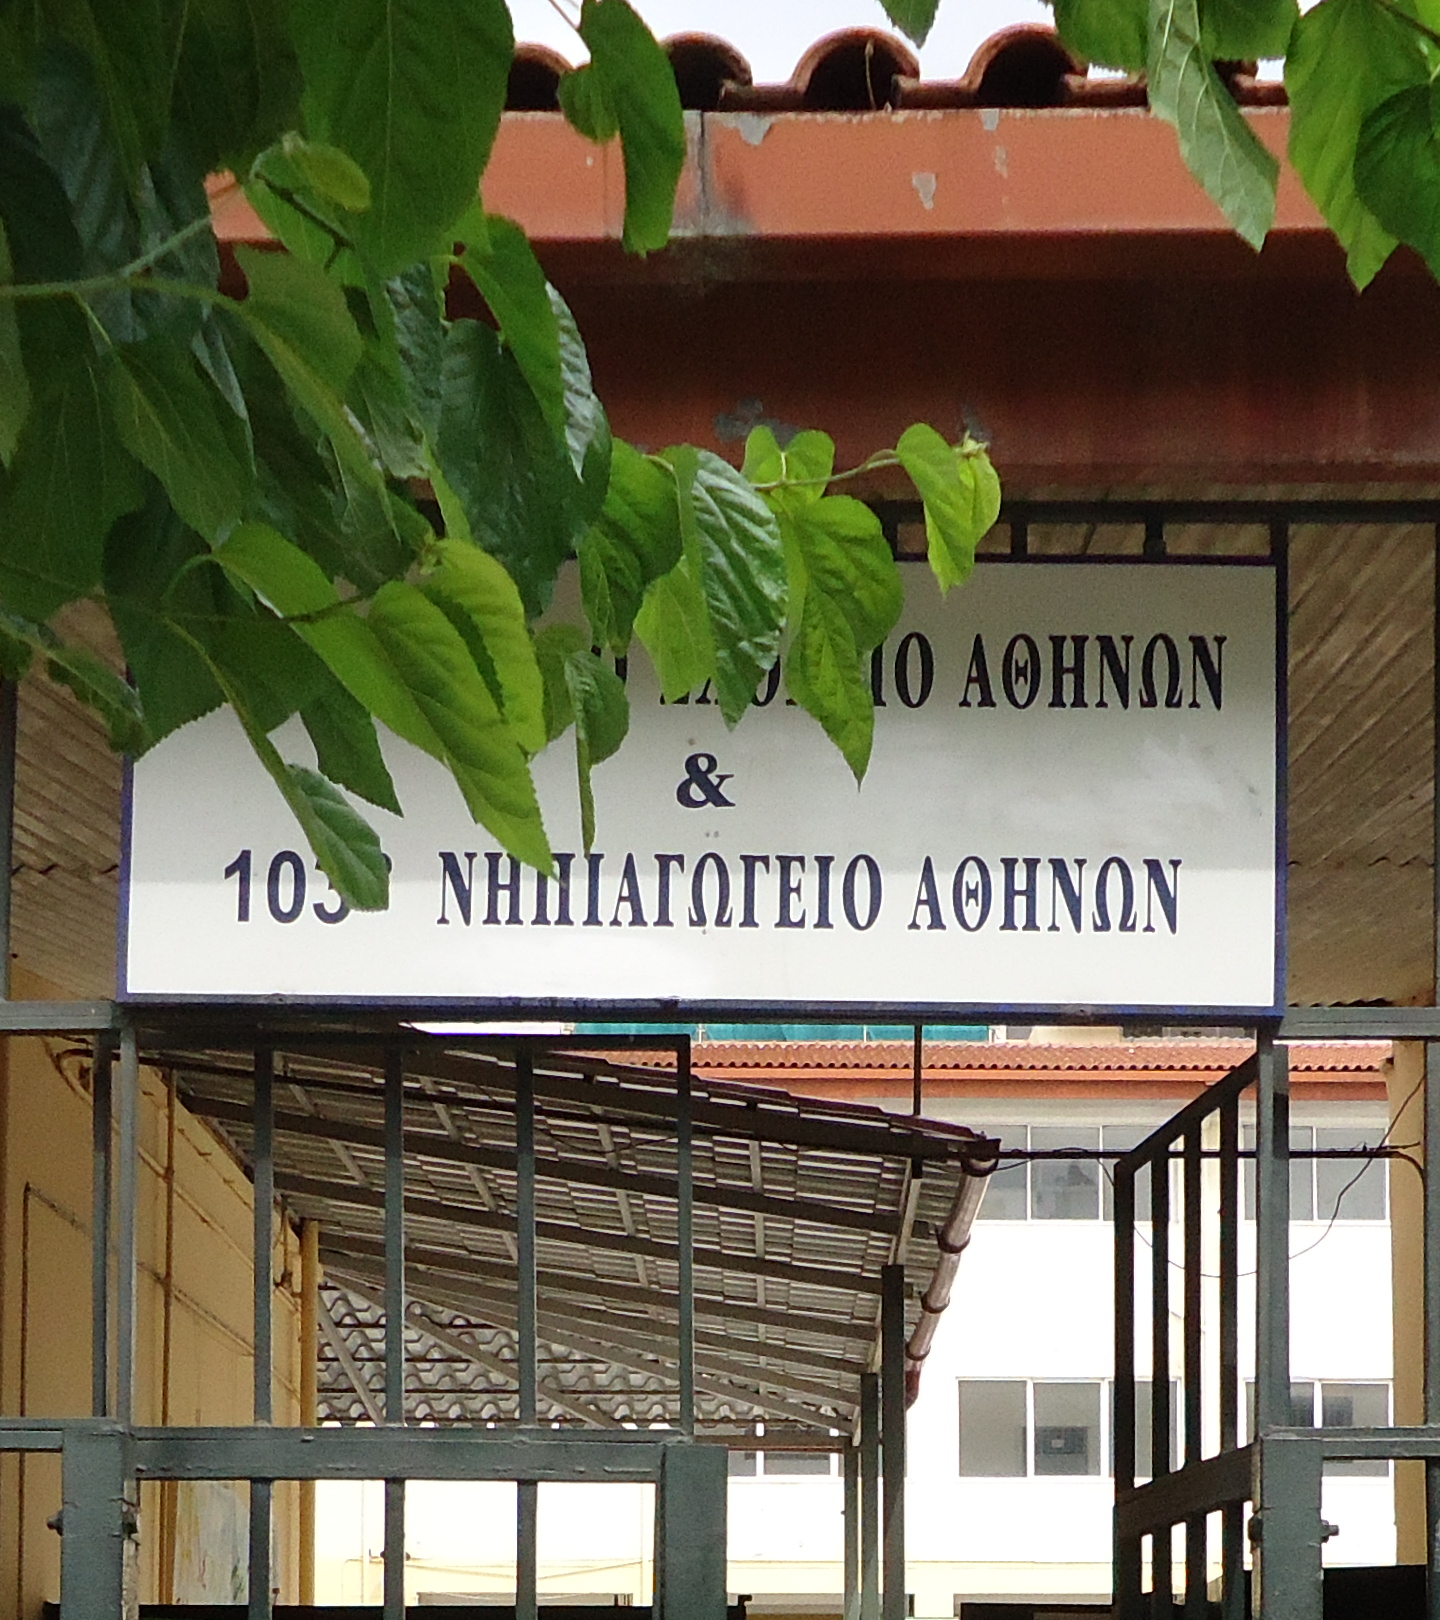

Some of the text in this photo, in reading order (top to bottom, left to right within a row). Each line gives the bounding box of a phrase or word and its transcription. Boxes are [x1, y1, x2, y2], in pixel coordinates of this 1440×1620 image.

[958, 631, 1228, 711] ΑΘΗΝΩΝ
[675, 752, 737, 810] &
[436, 850, 883, 932] ΝΗΠΙΑΓΩΓΕΙΟ
[907, 855, 1183, 935] ΑΘΗΝΩΝ
